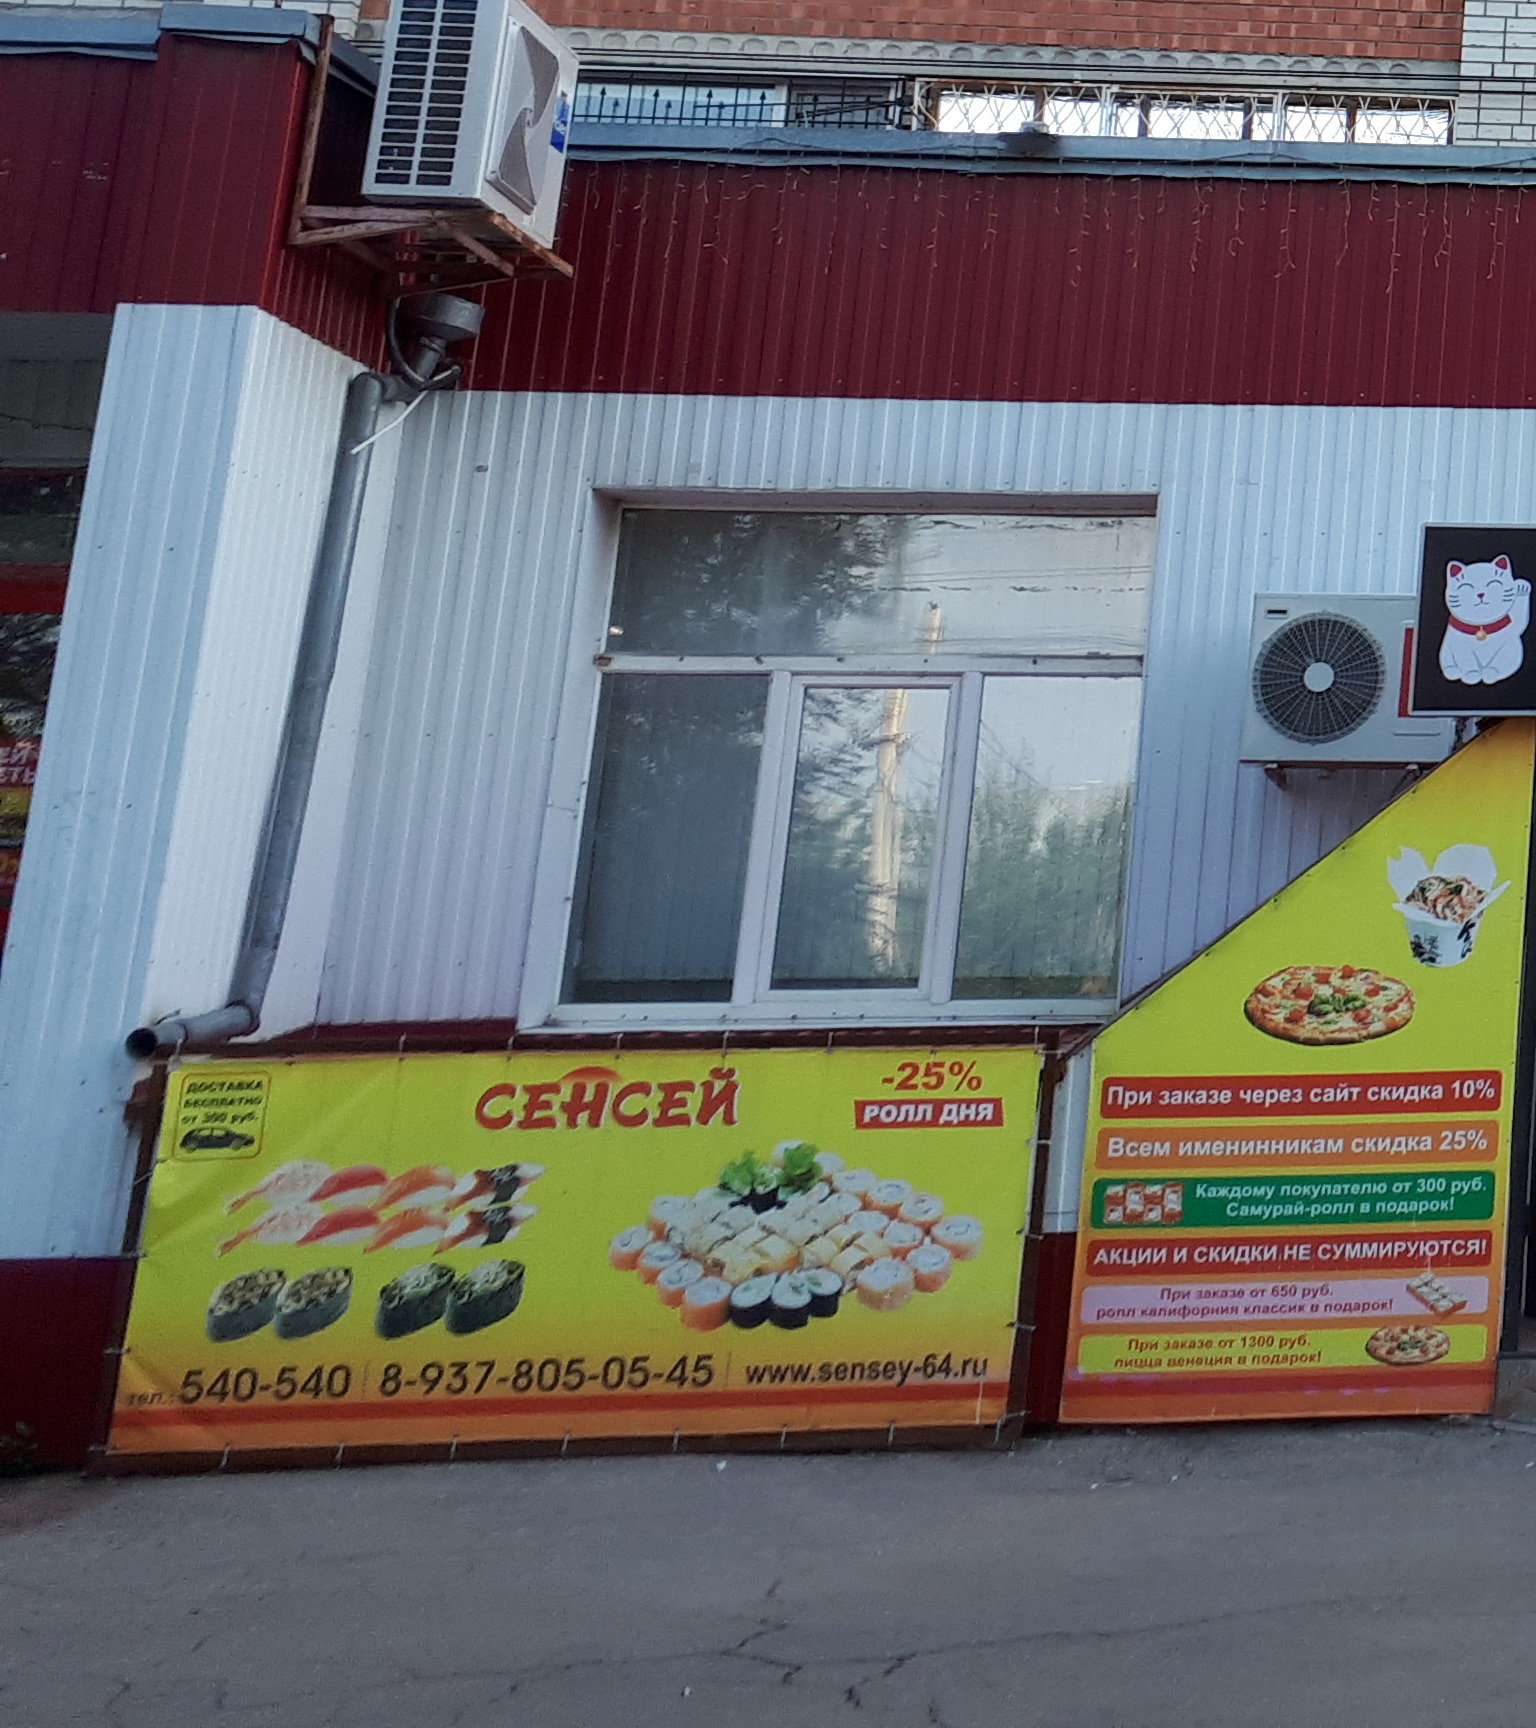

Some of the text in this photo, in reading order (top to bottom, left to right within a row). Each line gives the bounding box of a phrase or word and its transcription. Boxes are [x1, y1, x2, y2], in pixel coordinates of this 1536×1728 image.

[186, 1080, 263, 1093] ДОСТАВКА
[881, 1060, 983, 1093] -25%
[475, 1067, 741, 1130] СЕНСЕЙ
[1107, 1079, 1496, 1108] При заказе через сайт скидка 10%
[862, 1101, 994, 1125] РОЛЛ ДНЯ
[1108, 1129, 1488, 1157] Всем именинникам скидка 25%
[1196, 1177, 1487, 1200] Каждому покупателю от 300 руб.
[1227, 1197, 1454, 1219] Самурай-ролл в подарок!
[1094, 1239, 1487, 1266] АКЦИИ И СКИДКИ НЕ СУММИРУЮТСЯ!
[1160, 1284, 1333, 1303] При заказе от 650 руб.
[1141, 1303, 1239, 1320] калифорния
[1243, 1301, 1305, 1314] классик
[1324, 1298, 1393, 1314] подарок!
[1128, 1338, 1158, 1352] При
[1164, 1338, 1214, 1351] заказе
[1218, 1338, 1235, 1349] от
[1279, 1335, 1311, 1351] руб.
[1114, 1356, 1163, 1370] пицца
[1251, 1351, 1321, 1367] подарок!
[180, 1363, 352, 1404] 540-540
[380, 1354, 714, 1398] 8-937-805-05-45
[746, 1352, 988, 1387] www.sensey-64.ru
